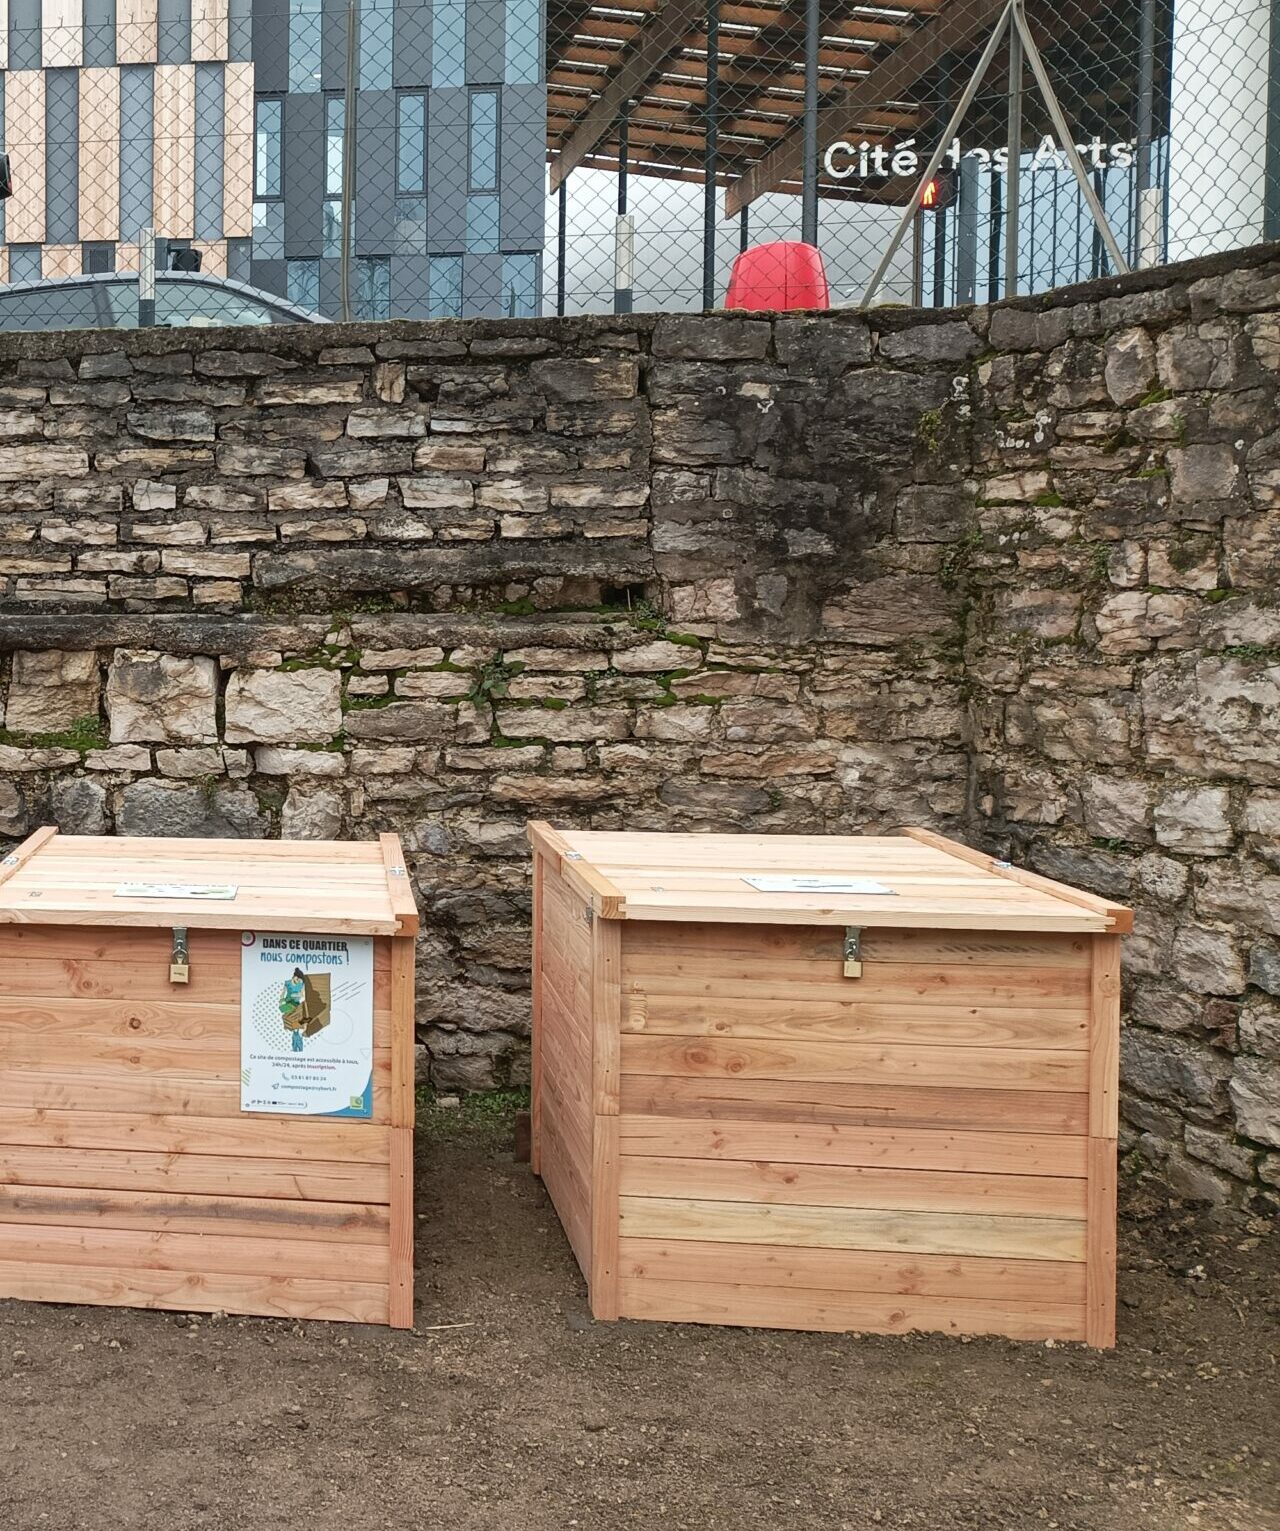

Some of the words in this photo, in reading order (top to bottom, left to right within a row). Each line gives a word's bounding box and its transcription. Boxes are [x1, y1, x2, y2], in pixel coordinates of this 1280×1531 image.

[823, 138, 918, 179] Cité
[263, 938, 287, 949] DANS
[289, 939, 300, 950] CE
[302, 940, 347, 952] QUARTIER
[261, 952, 282, 962] nous
[285, 952, 342, 970] compostons
